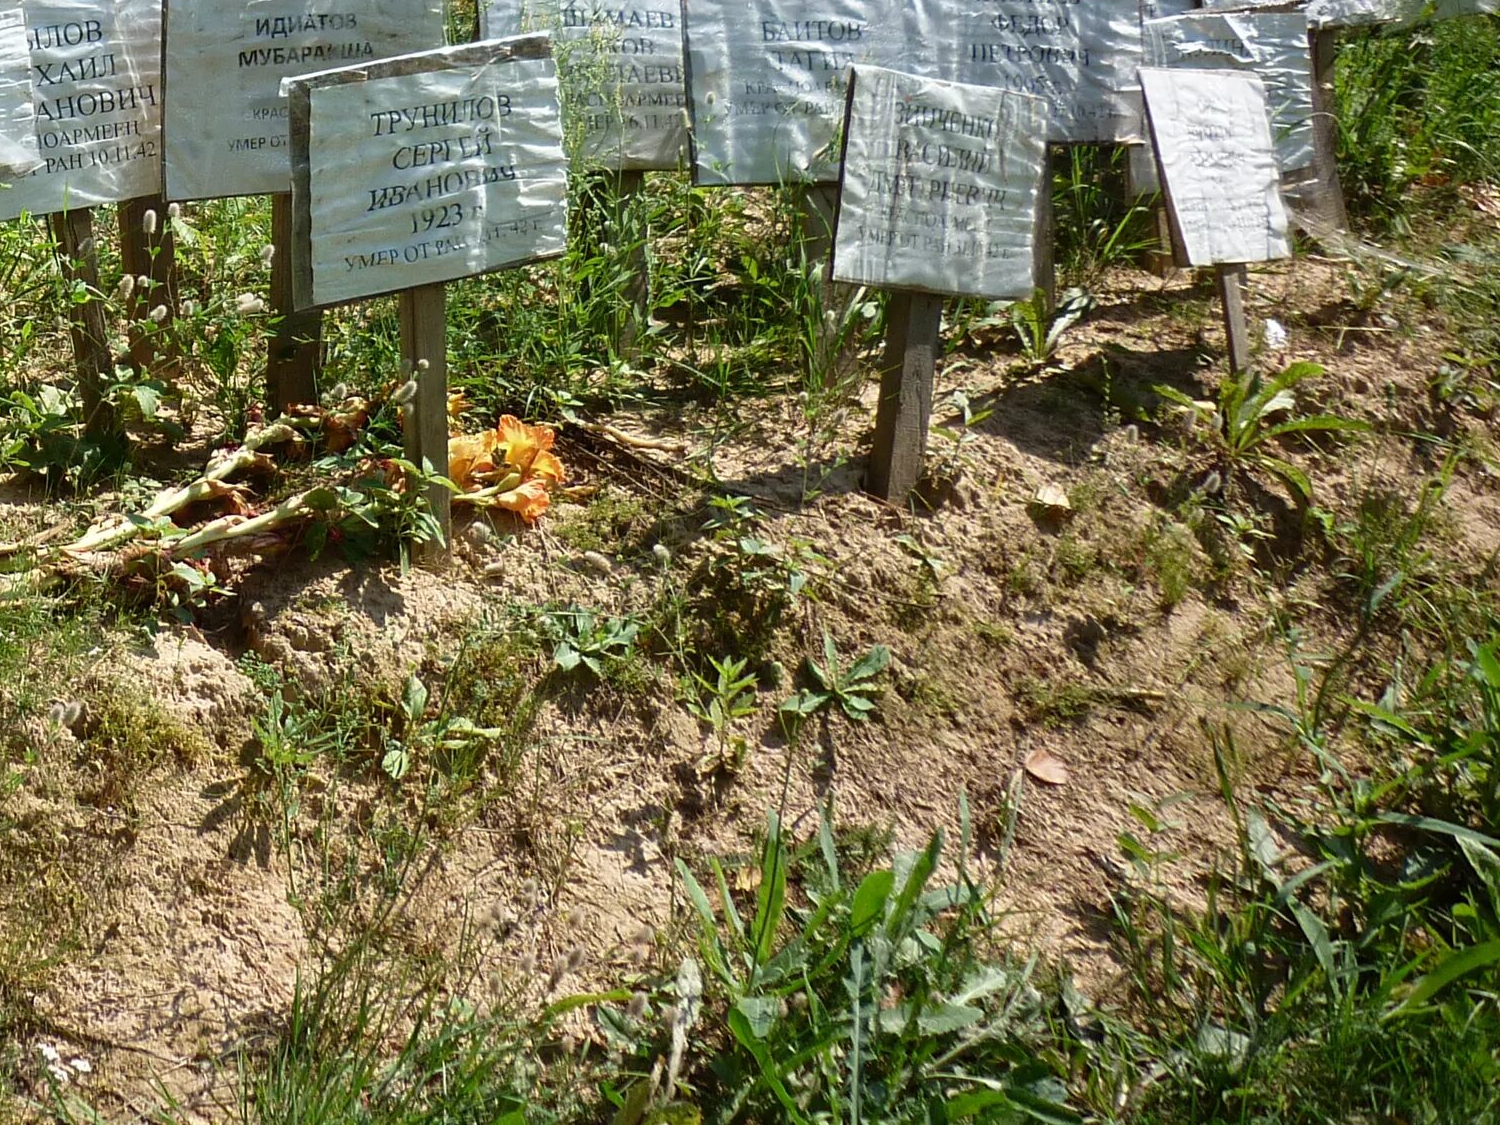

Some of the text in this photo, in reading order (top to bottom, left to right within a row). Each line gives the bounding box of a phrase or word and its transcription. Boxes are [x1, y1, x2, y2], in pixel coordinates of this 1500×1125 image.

[255, 12, 358, 39] ИДИАТОВ
[760, 20, 863, 42] БАИТОВ
[35, 53, 117, 87] ХАИЛ
[35, 83, 157, 123] АНОВИЧ
[251, 105, 290, 121] КРАС
[370, 93, 513, 138] ТРУНИЛОВ
[45, 153, 84, 174] РАН
[89, 140, 157, 167] 10.11.42
[226, 137, 267, 153] УМЕР
[393, 126, 494, 171] СЕРГЕЙ
[366, 164, 517, 212] ИВАНОВИЧ
[411, 202, 464, 234] 1923
[344, 248, 399, 273] УМЕР
[403, 242, 431, 264] ОТ
